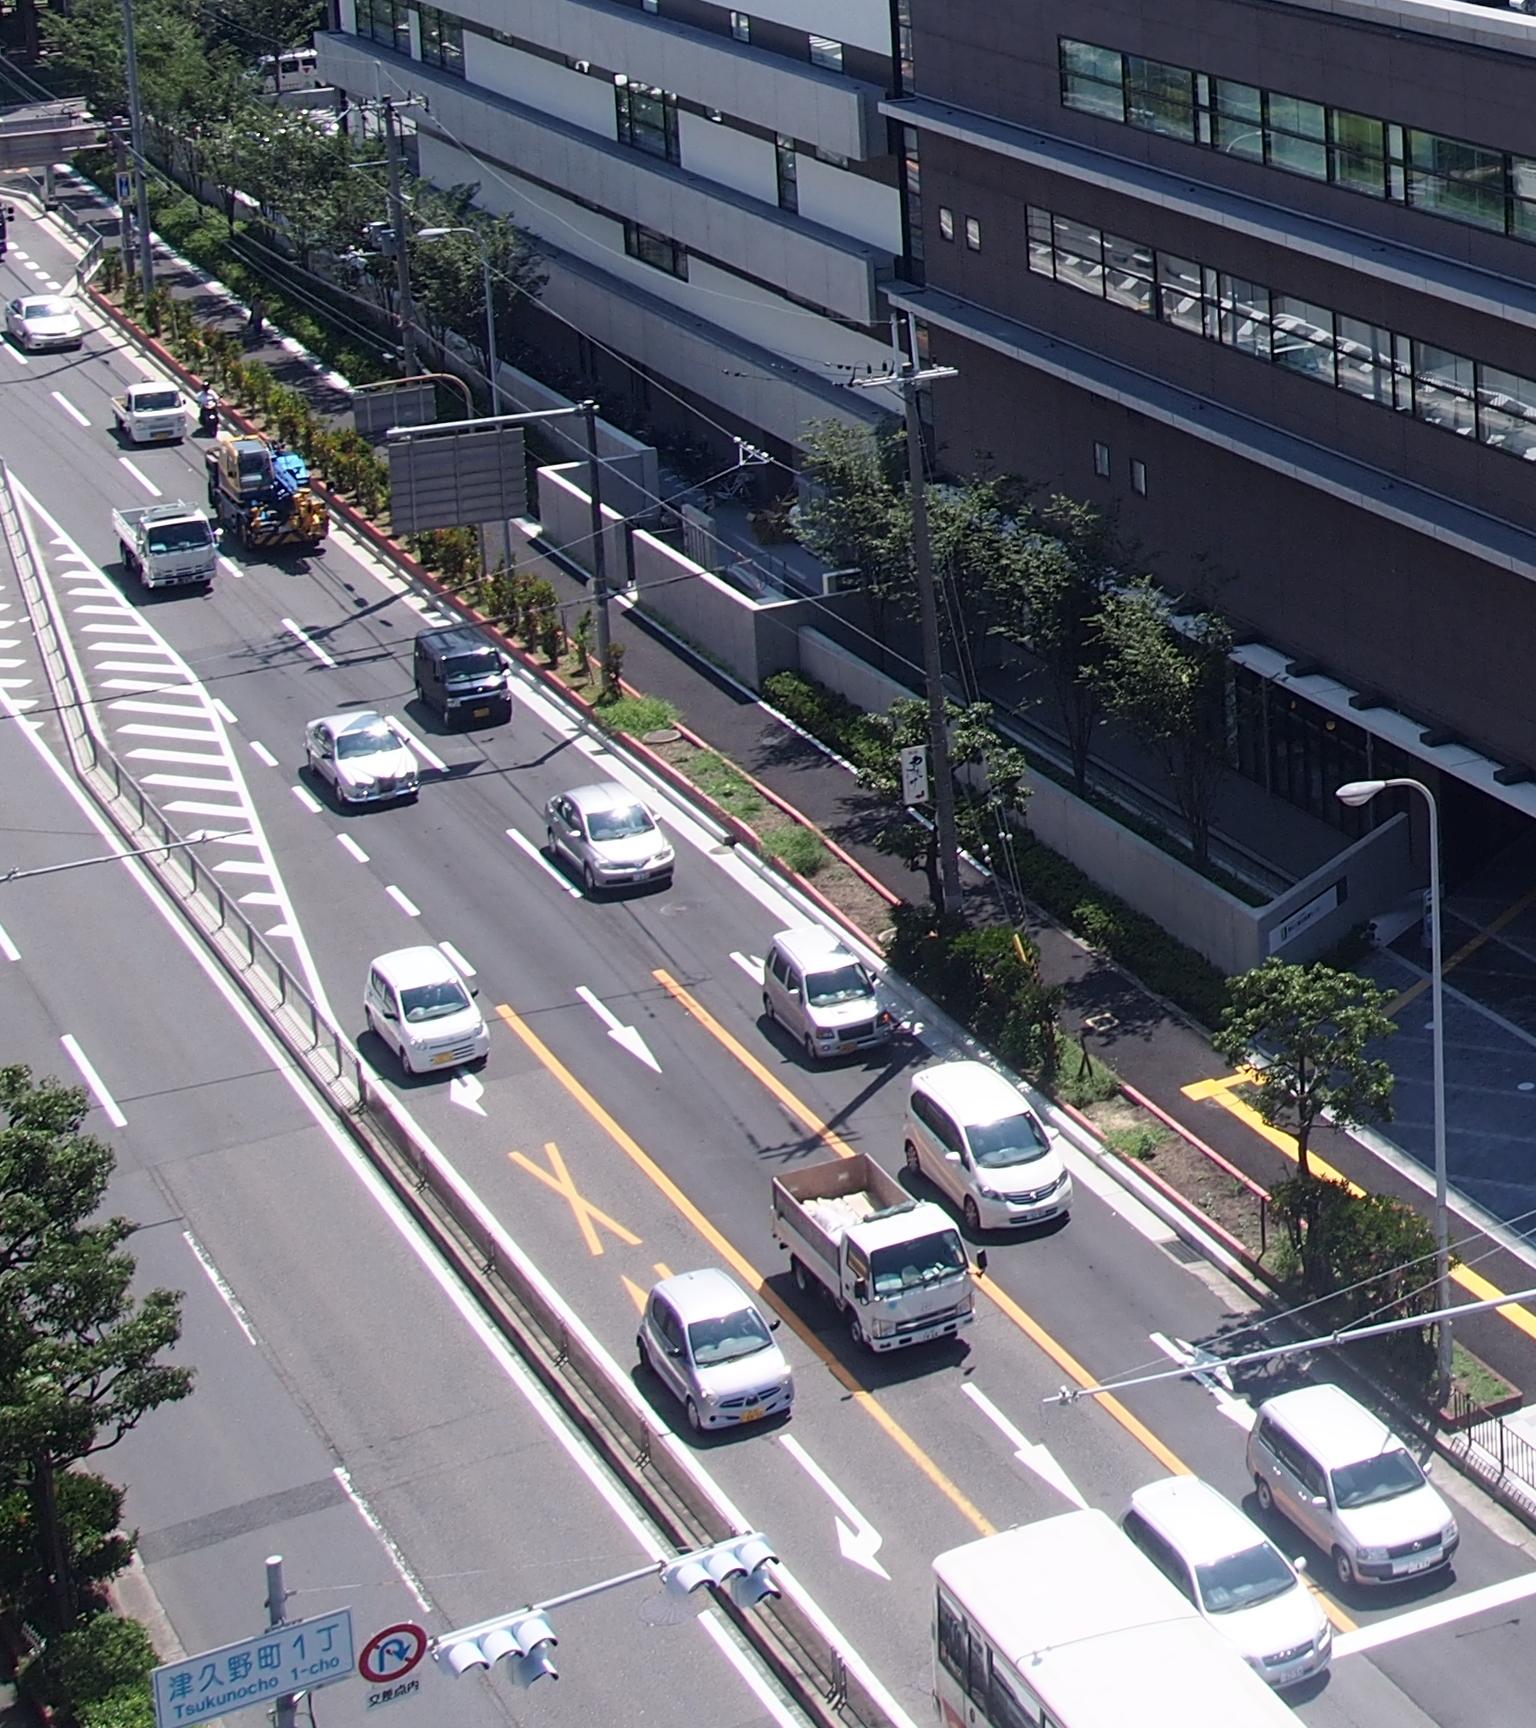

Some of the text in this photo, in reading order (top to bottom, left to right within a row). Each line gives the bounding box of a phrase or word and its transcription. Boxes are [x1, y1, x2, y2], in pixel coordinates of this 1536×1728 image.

[168, 1623, 340, 1702] 津久野町1丁
[173, 1656, 340, 1719] Tsukunocho 1-cho
